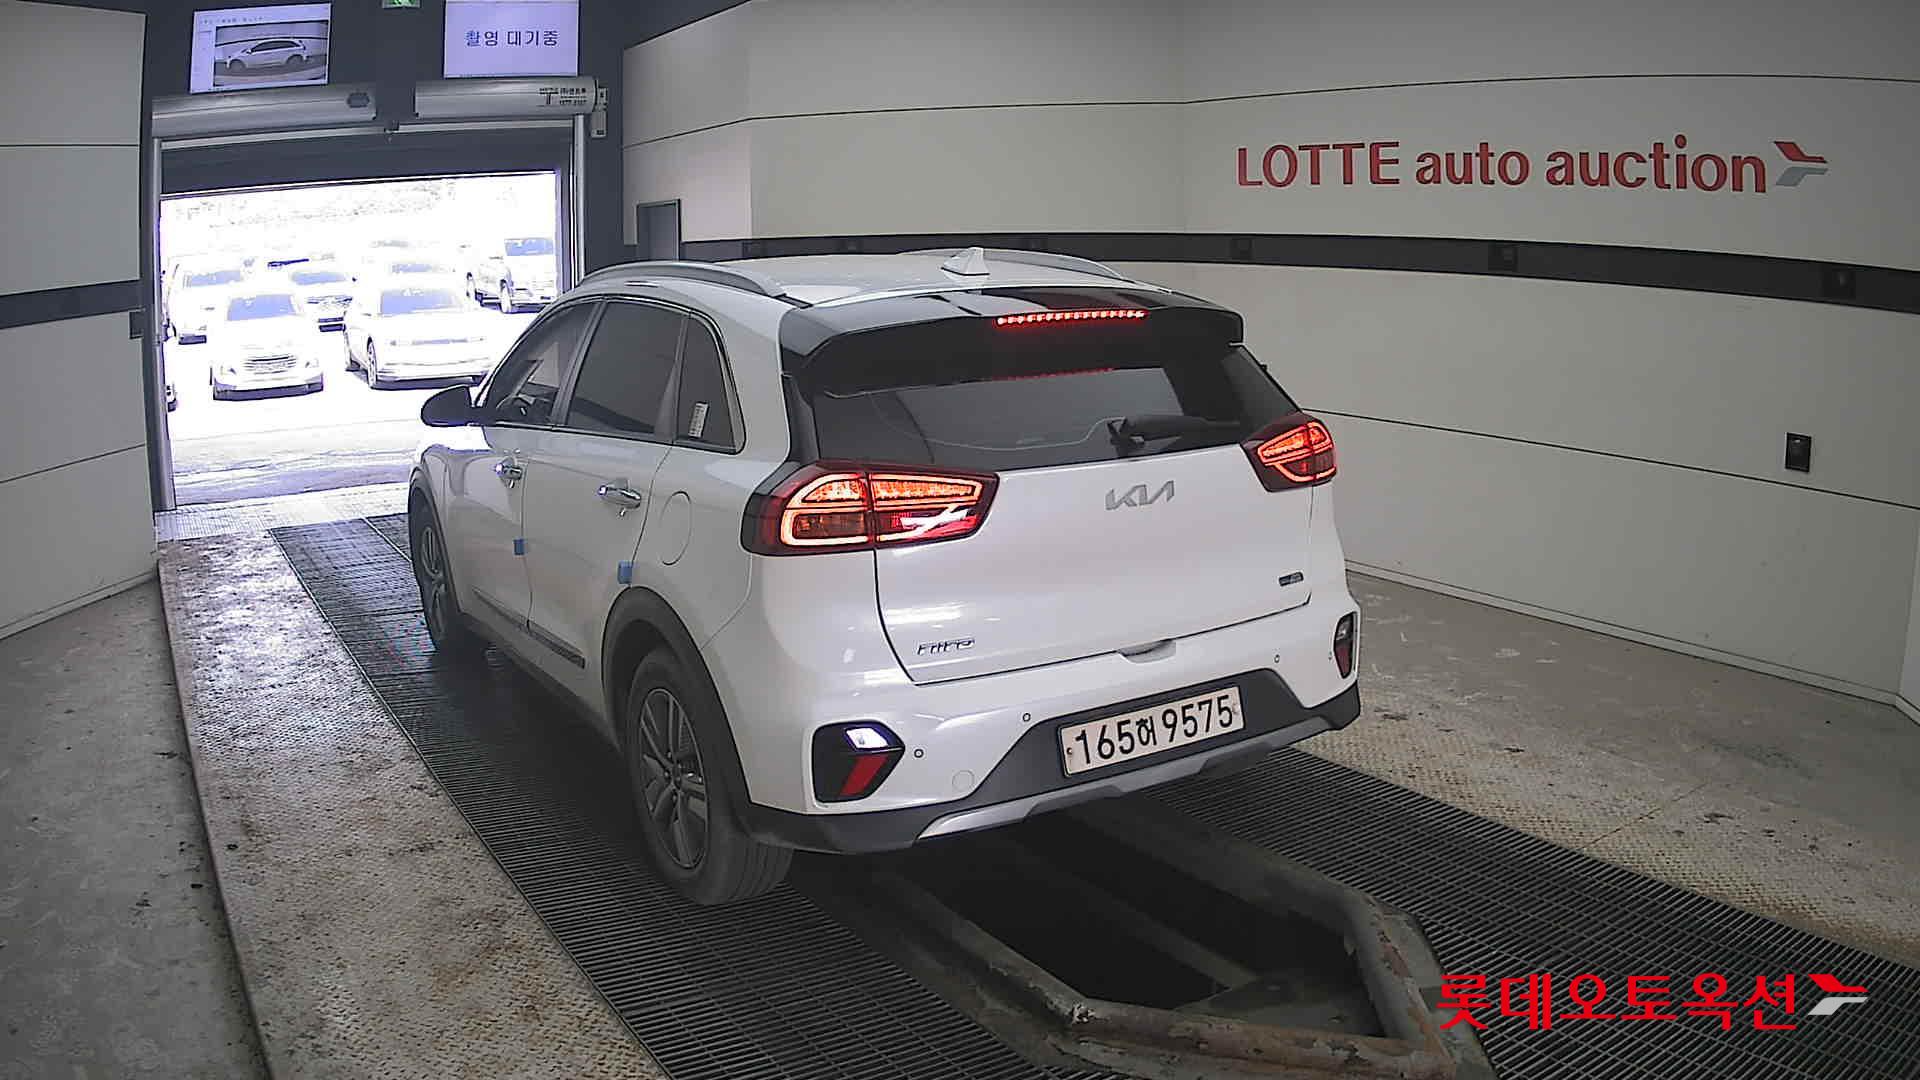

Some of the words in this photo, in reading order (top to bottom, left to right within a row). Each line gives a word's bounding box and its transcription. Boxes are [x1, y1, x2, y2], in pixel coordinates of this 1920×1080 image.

[465, 29, 498, 47] 촬영
[507, 30, 560, 47] 대기중
[1236, 141, 1400, 188] LOTTE
[1415, 142, 1531, 186] auto
[1545, 134, 1767, 193] auction
[1105, 480, 1175, 510] KIA
[1075, 715, 1158, 764] 165허
[1161, 694, 1233, 743] 9575
